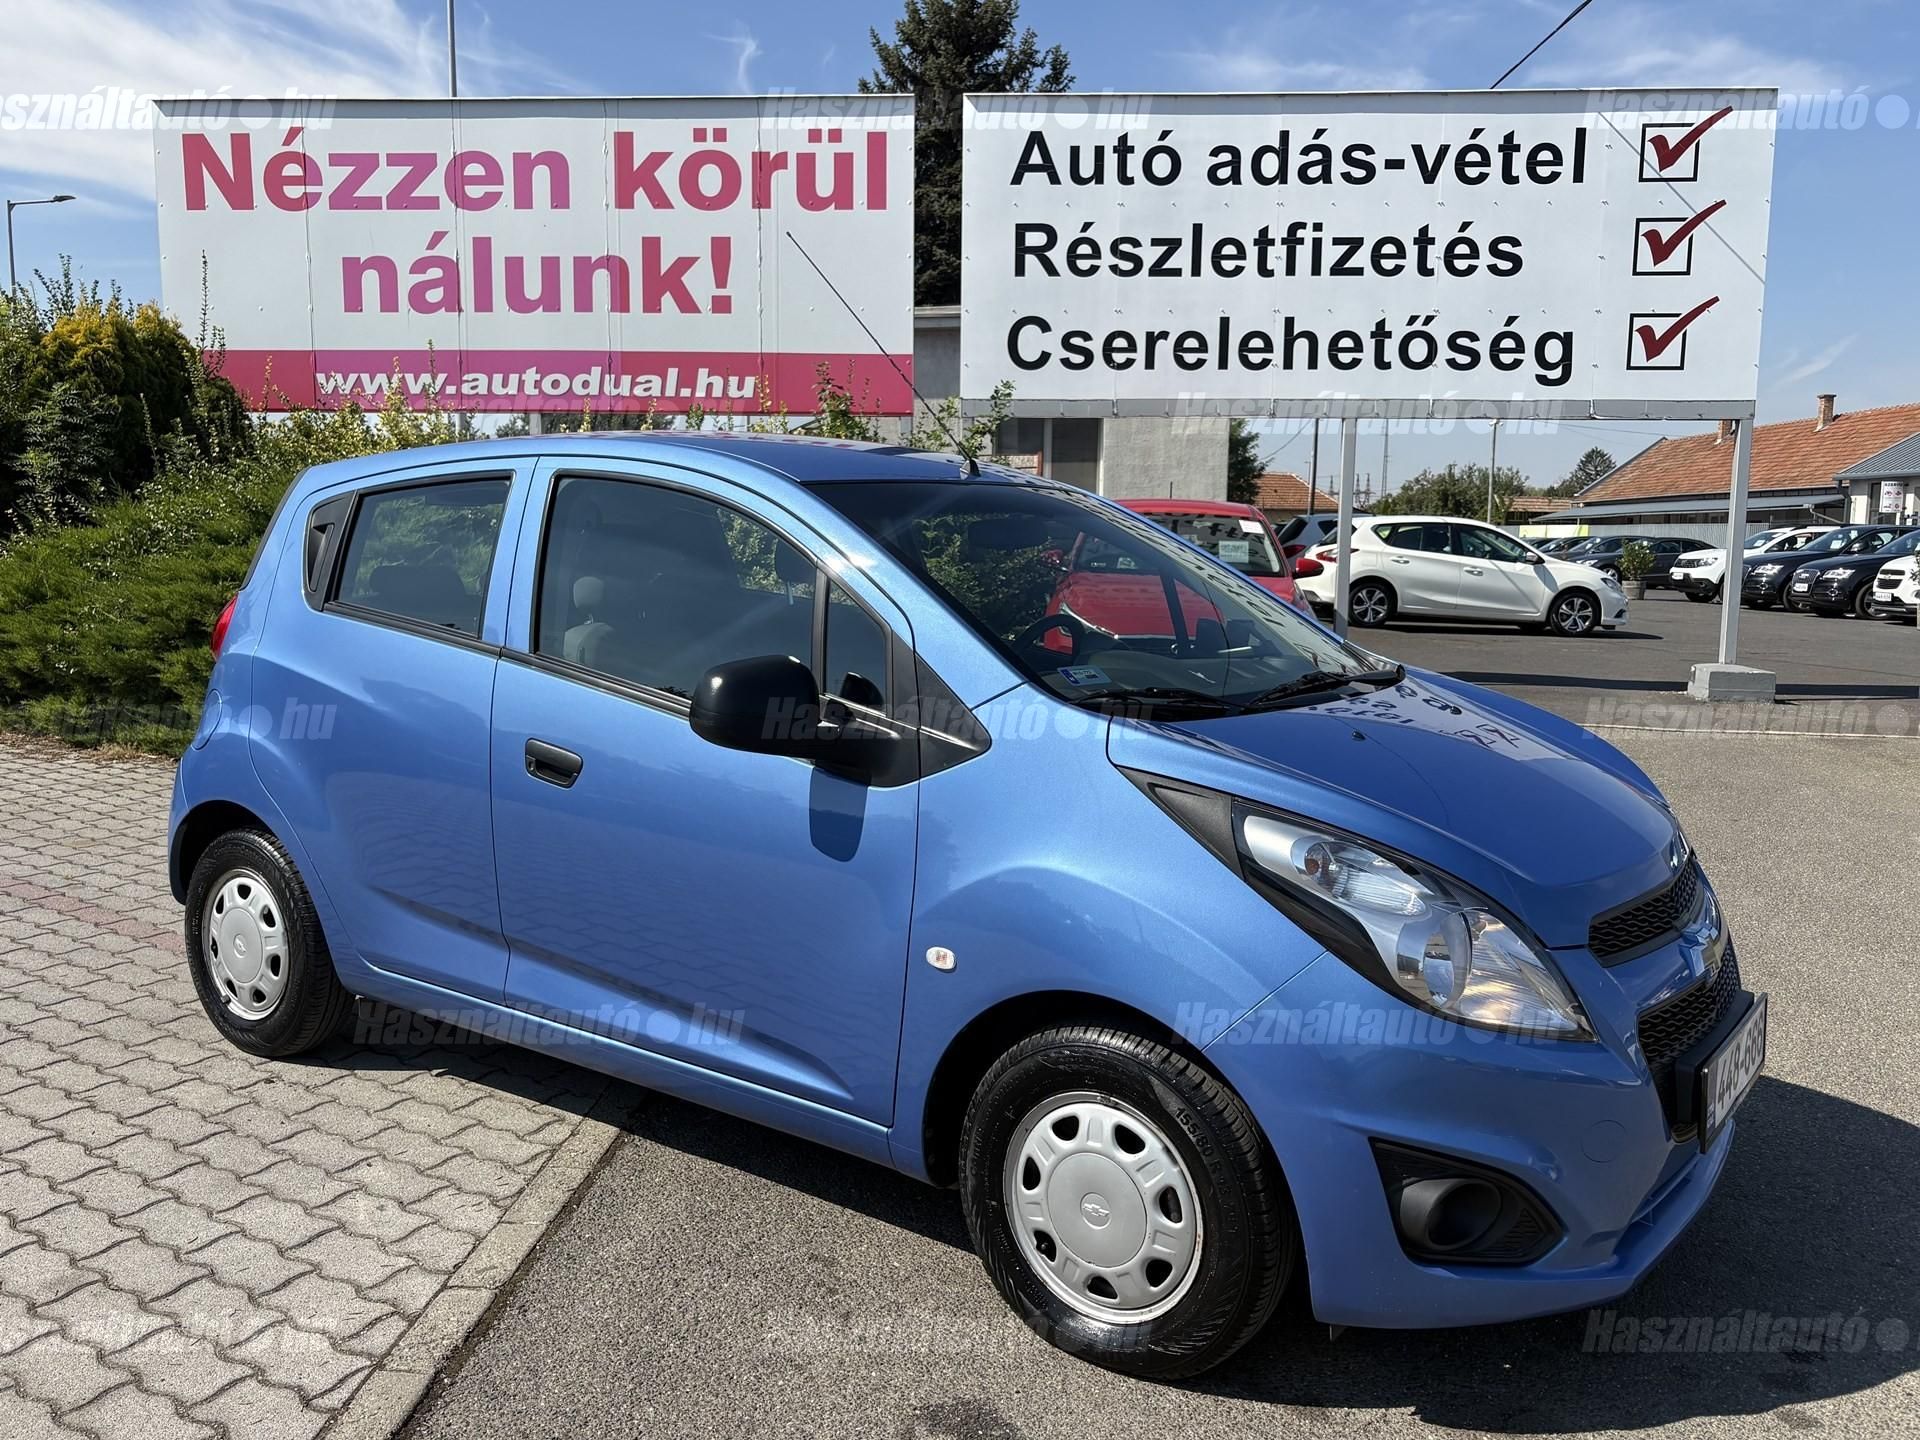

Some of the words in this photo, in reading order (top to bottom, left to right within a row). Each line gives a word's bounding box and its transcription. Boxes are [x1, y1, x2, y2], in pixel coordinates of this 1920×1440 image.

[182, 126, 570, 212] Nézzen
[614, 127, 888, 212] körül
[1010, 129, 1182, 187] Autó
[1206, 127, 1587, 186] adás-vétel
[342, 231, 732, 314] nálunk!
[1013, 221, 1524, 278] Részletfizetés
[316, 366, 755, 399] www.autodual.hu
[1006, 314, 1575, 387] Cserelehetőség
